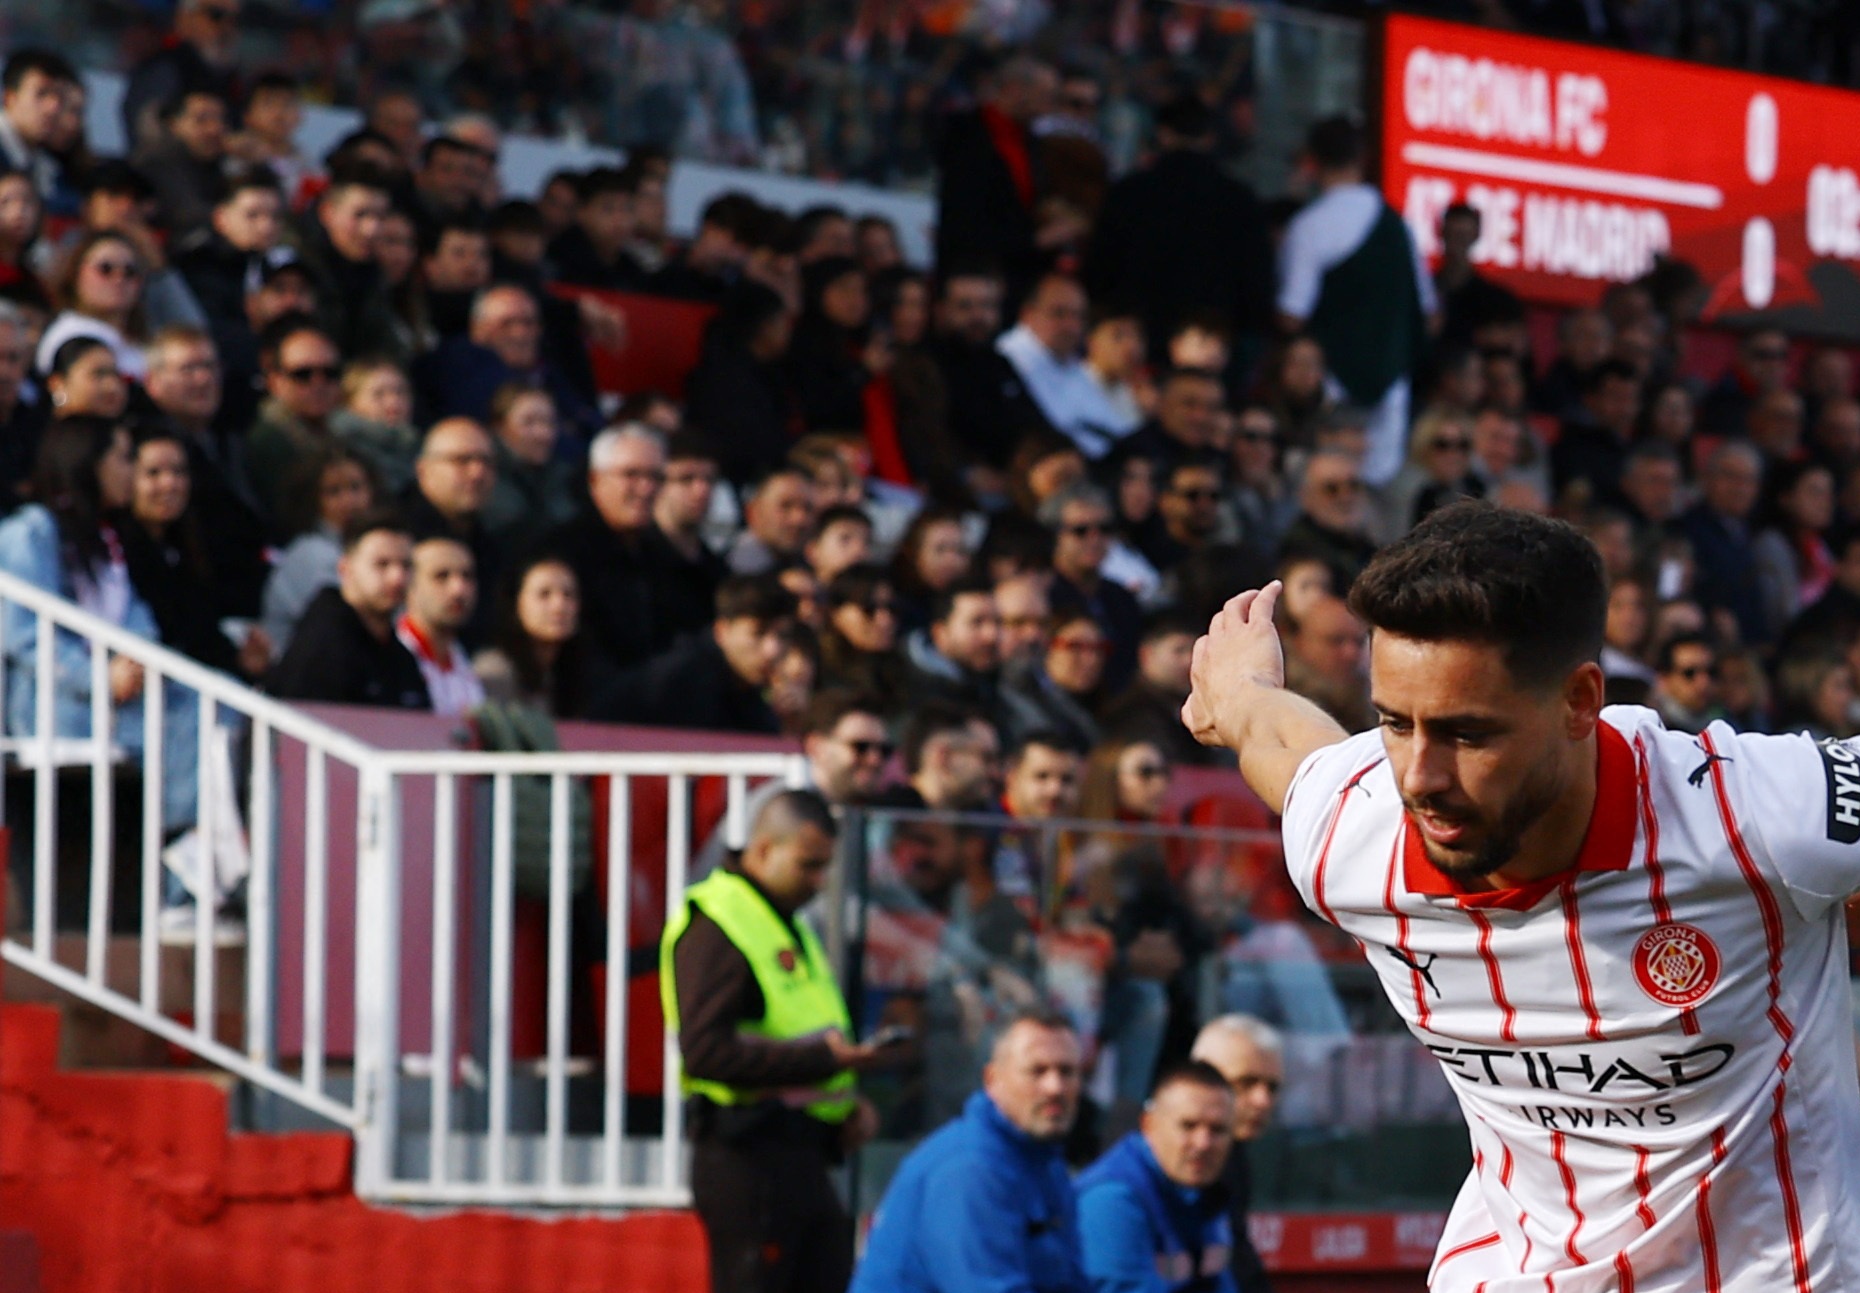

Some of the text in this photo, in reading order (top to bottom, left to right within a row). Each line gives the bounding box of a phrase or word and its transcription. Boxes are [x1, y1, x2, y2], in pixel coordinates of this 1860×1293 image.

[1403, 47, 1608, 157] GIRONA FC
[1745, 92, 1779, 185] 0
[1742, 218, 1776, 308] 0
[1642, 928, 1697, 951] GIRONA
[1426, 1044, 1735, 1092] ETIHAD
[1508, 1104, 1676, 1129] IRWAYS
